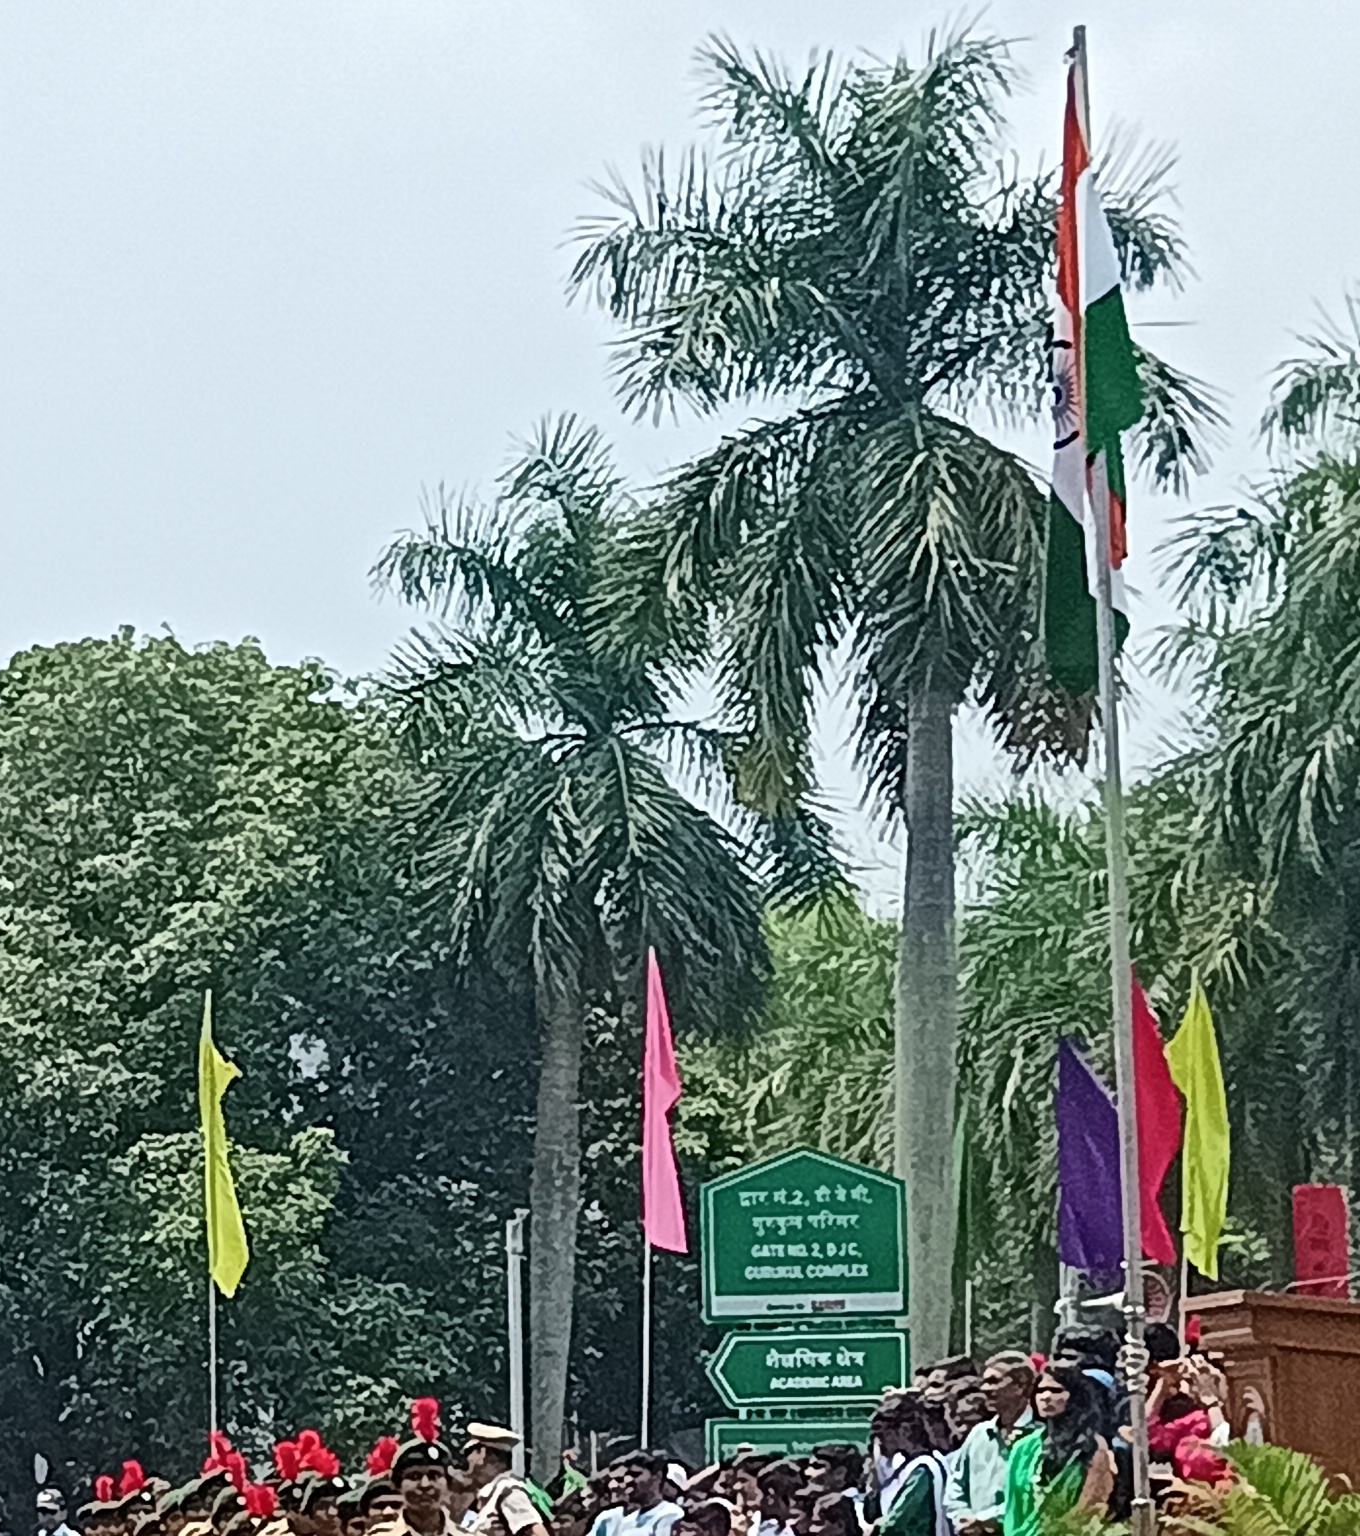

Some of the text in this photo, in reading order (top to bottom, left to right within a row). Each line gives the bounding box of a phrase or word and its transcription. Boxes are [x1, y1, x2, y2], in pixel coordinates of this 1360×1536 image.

[751, 1244, 785, 1258] GATE
[806, 1263, 869, 1279] COMPLEX
[769, 1374, 863, 1390] ACADEMIC AREA
